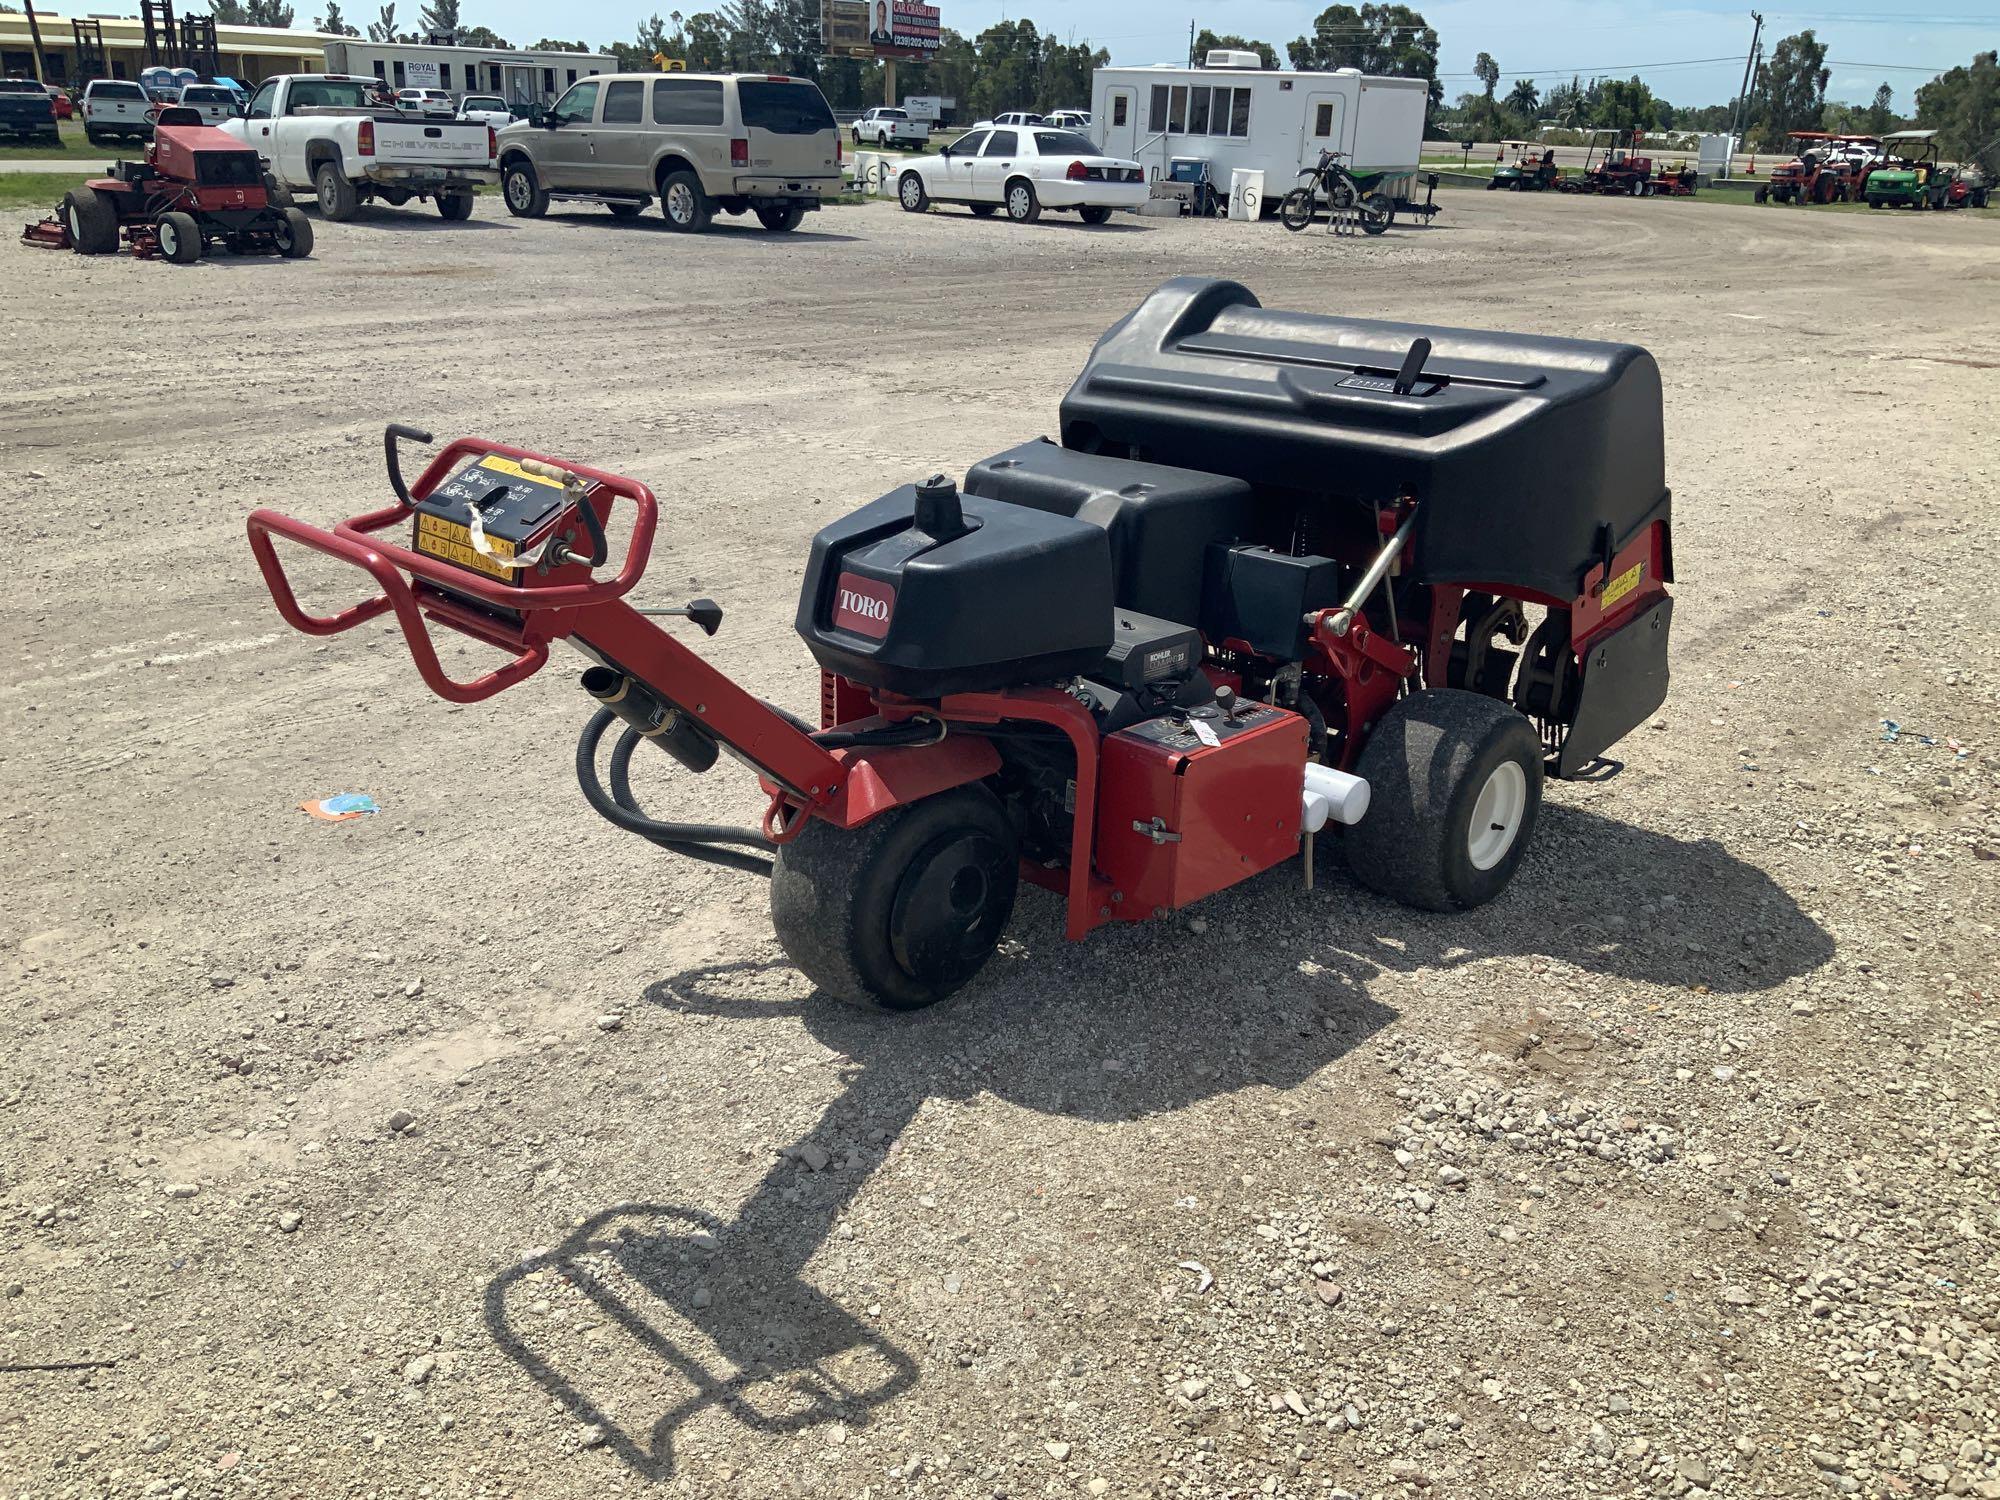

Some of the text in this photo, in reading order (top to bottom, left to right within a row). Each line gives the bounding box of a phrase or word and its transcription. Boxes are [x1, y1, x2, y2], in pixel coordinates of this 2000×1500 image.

[893, 2, 906, 13] CAR
[906, 3, 926, 16] CRASH
[408, 62, 437, 72] ROYAL
[380, 140, 483, 151] CHEVROLET
[840, 589, 889, 622] TORO
[1150, 650, 1171, 662] KOHLER
